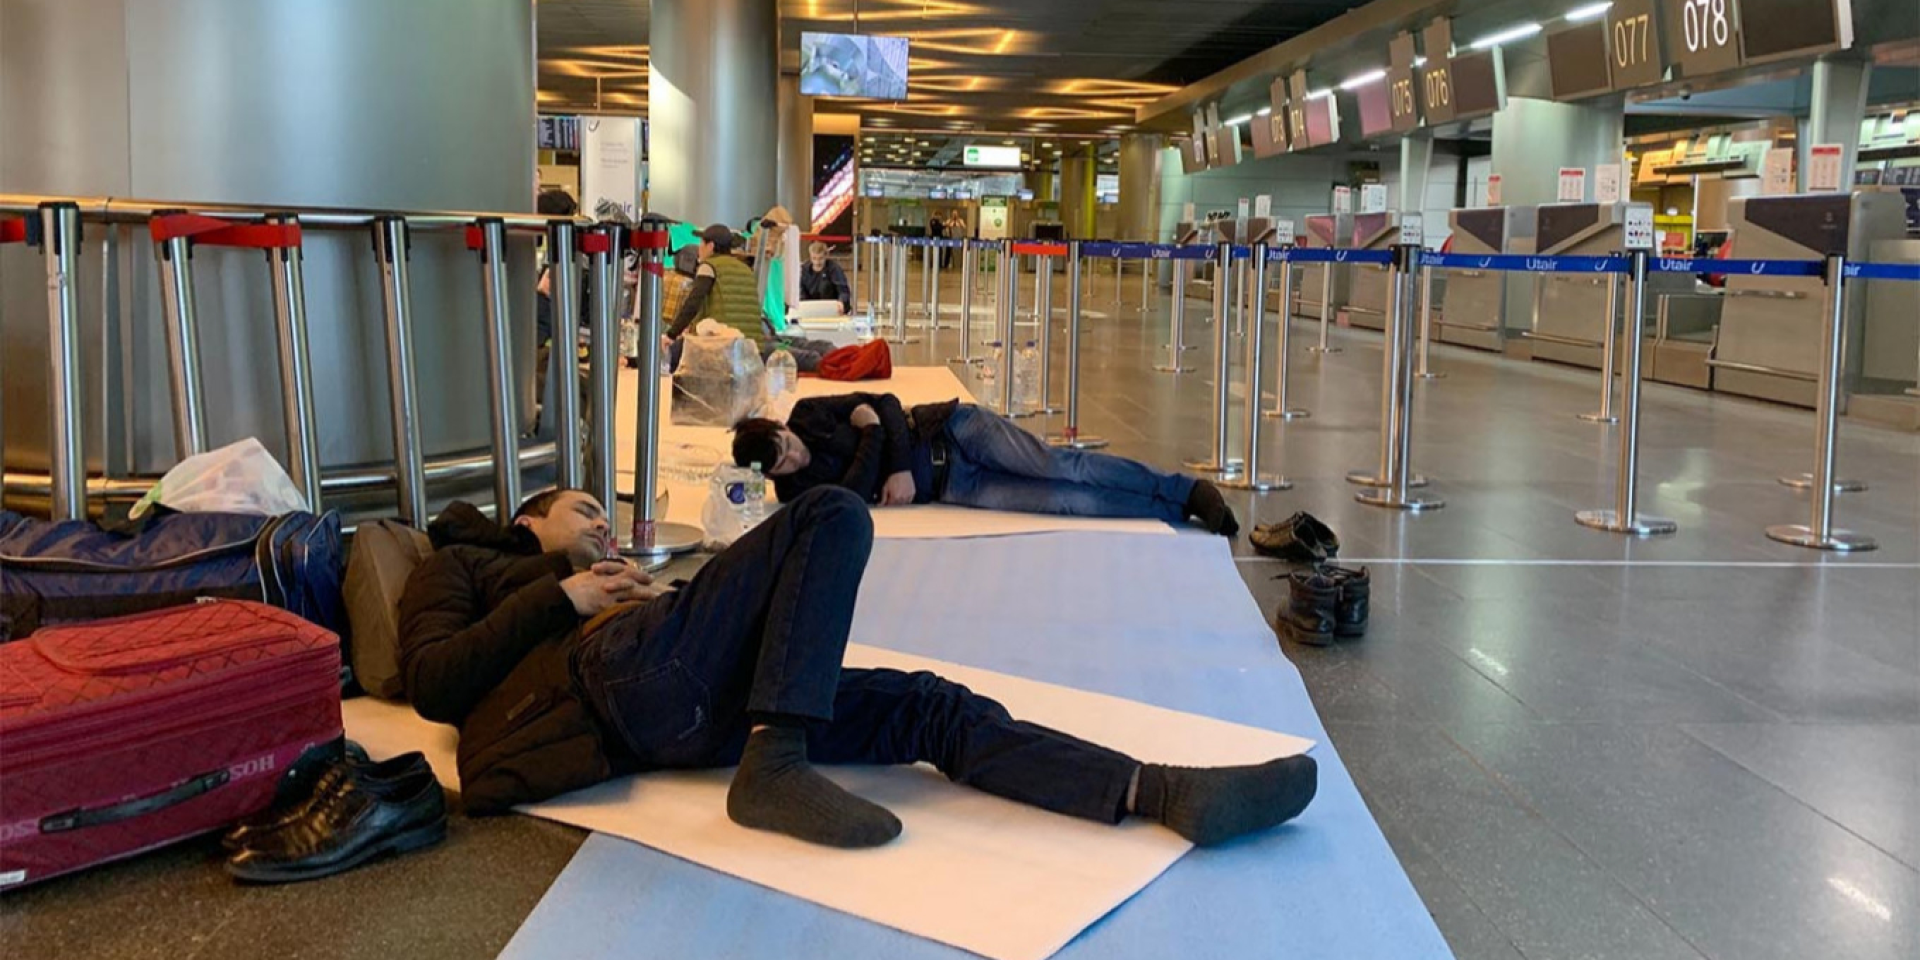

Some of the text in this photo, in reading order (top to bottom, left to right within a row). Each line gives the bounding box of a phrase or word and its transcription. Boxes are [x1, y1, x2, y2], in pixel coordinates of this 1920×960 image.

[1614, 13, 1649, 68] 077
[1684, 0, 1728, 52] 078
[1391, 79, 1413, 117] 075
[1426, 68, 1449, 109] 076
[1526, 257, 1558, 270] Utair
[1660, 257, 1693, 271] Utair
[1843, 263, 1861, 277] air
